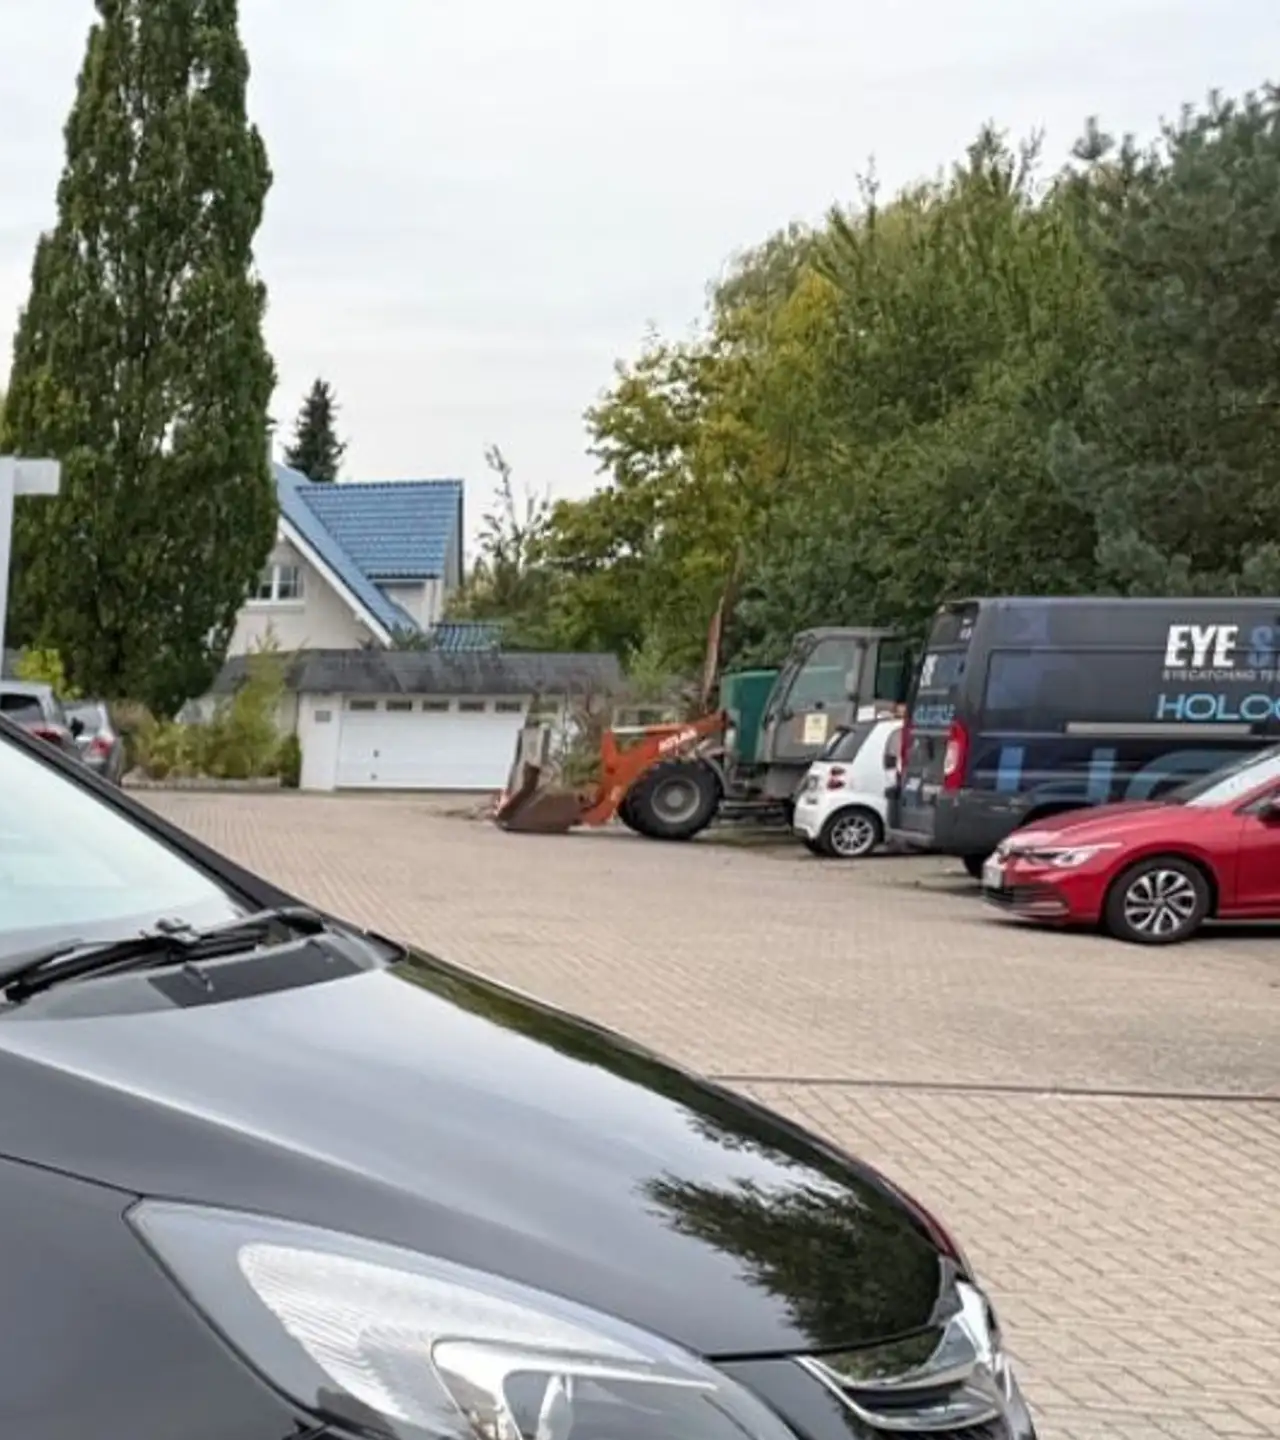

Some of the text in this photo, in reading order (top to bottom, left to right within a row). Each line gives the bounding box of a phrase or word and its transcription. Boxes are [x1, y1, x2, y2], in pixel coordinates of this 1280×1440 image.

[1165, 624, 1280, 668] EYE S
[1156, 693, 1280, 721] HOLO
